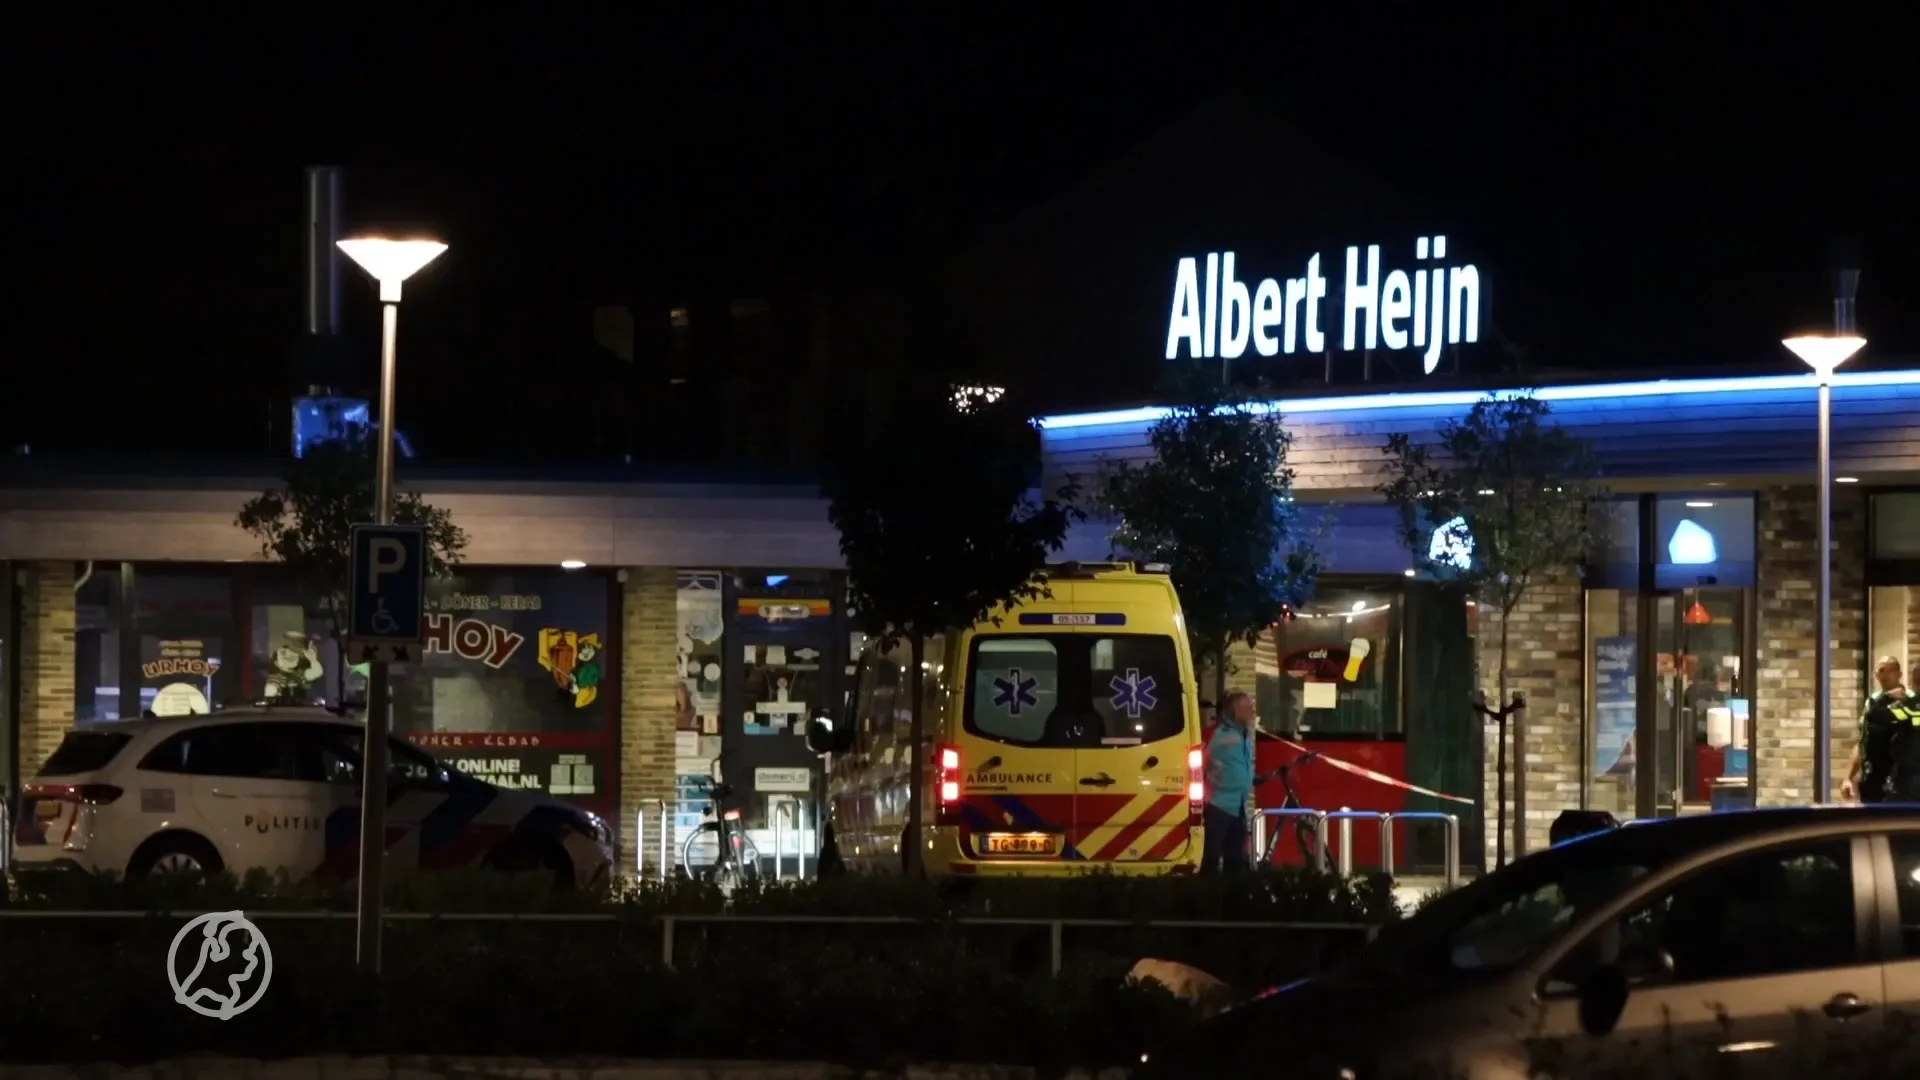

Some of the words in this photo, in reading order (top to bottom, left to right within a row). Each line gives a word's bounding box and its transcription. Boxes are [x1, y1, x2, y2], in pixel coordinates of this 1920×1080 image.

[1165, 251, 1326, 359] Albert
[1344, 235, 1480, 375] Heijn
[369, 537, 407, 594] P
[423, 613, 525, 668] HOY
[142, 659, 220, 678] URHOY
[484, 735, 540, 746] KEBAB
[456, 758, 521, 774] ONLINE!
[967, 773, 1053, 784] AMBULANCE
[245, 814, 321, 834] POLITIE
